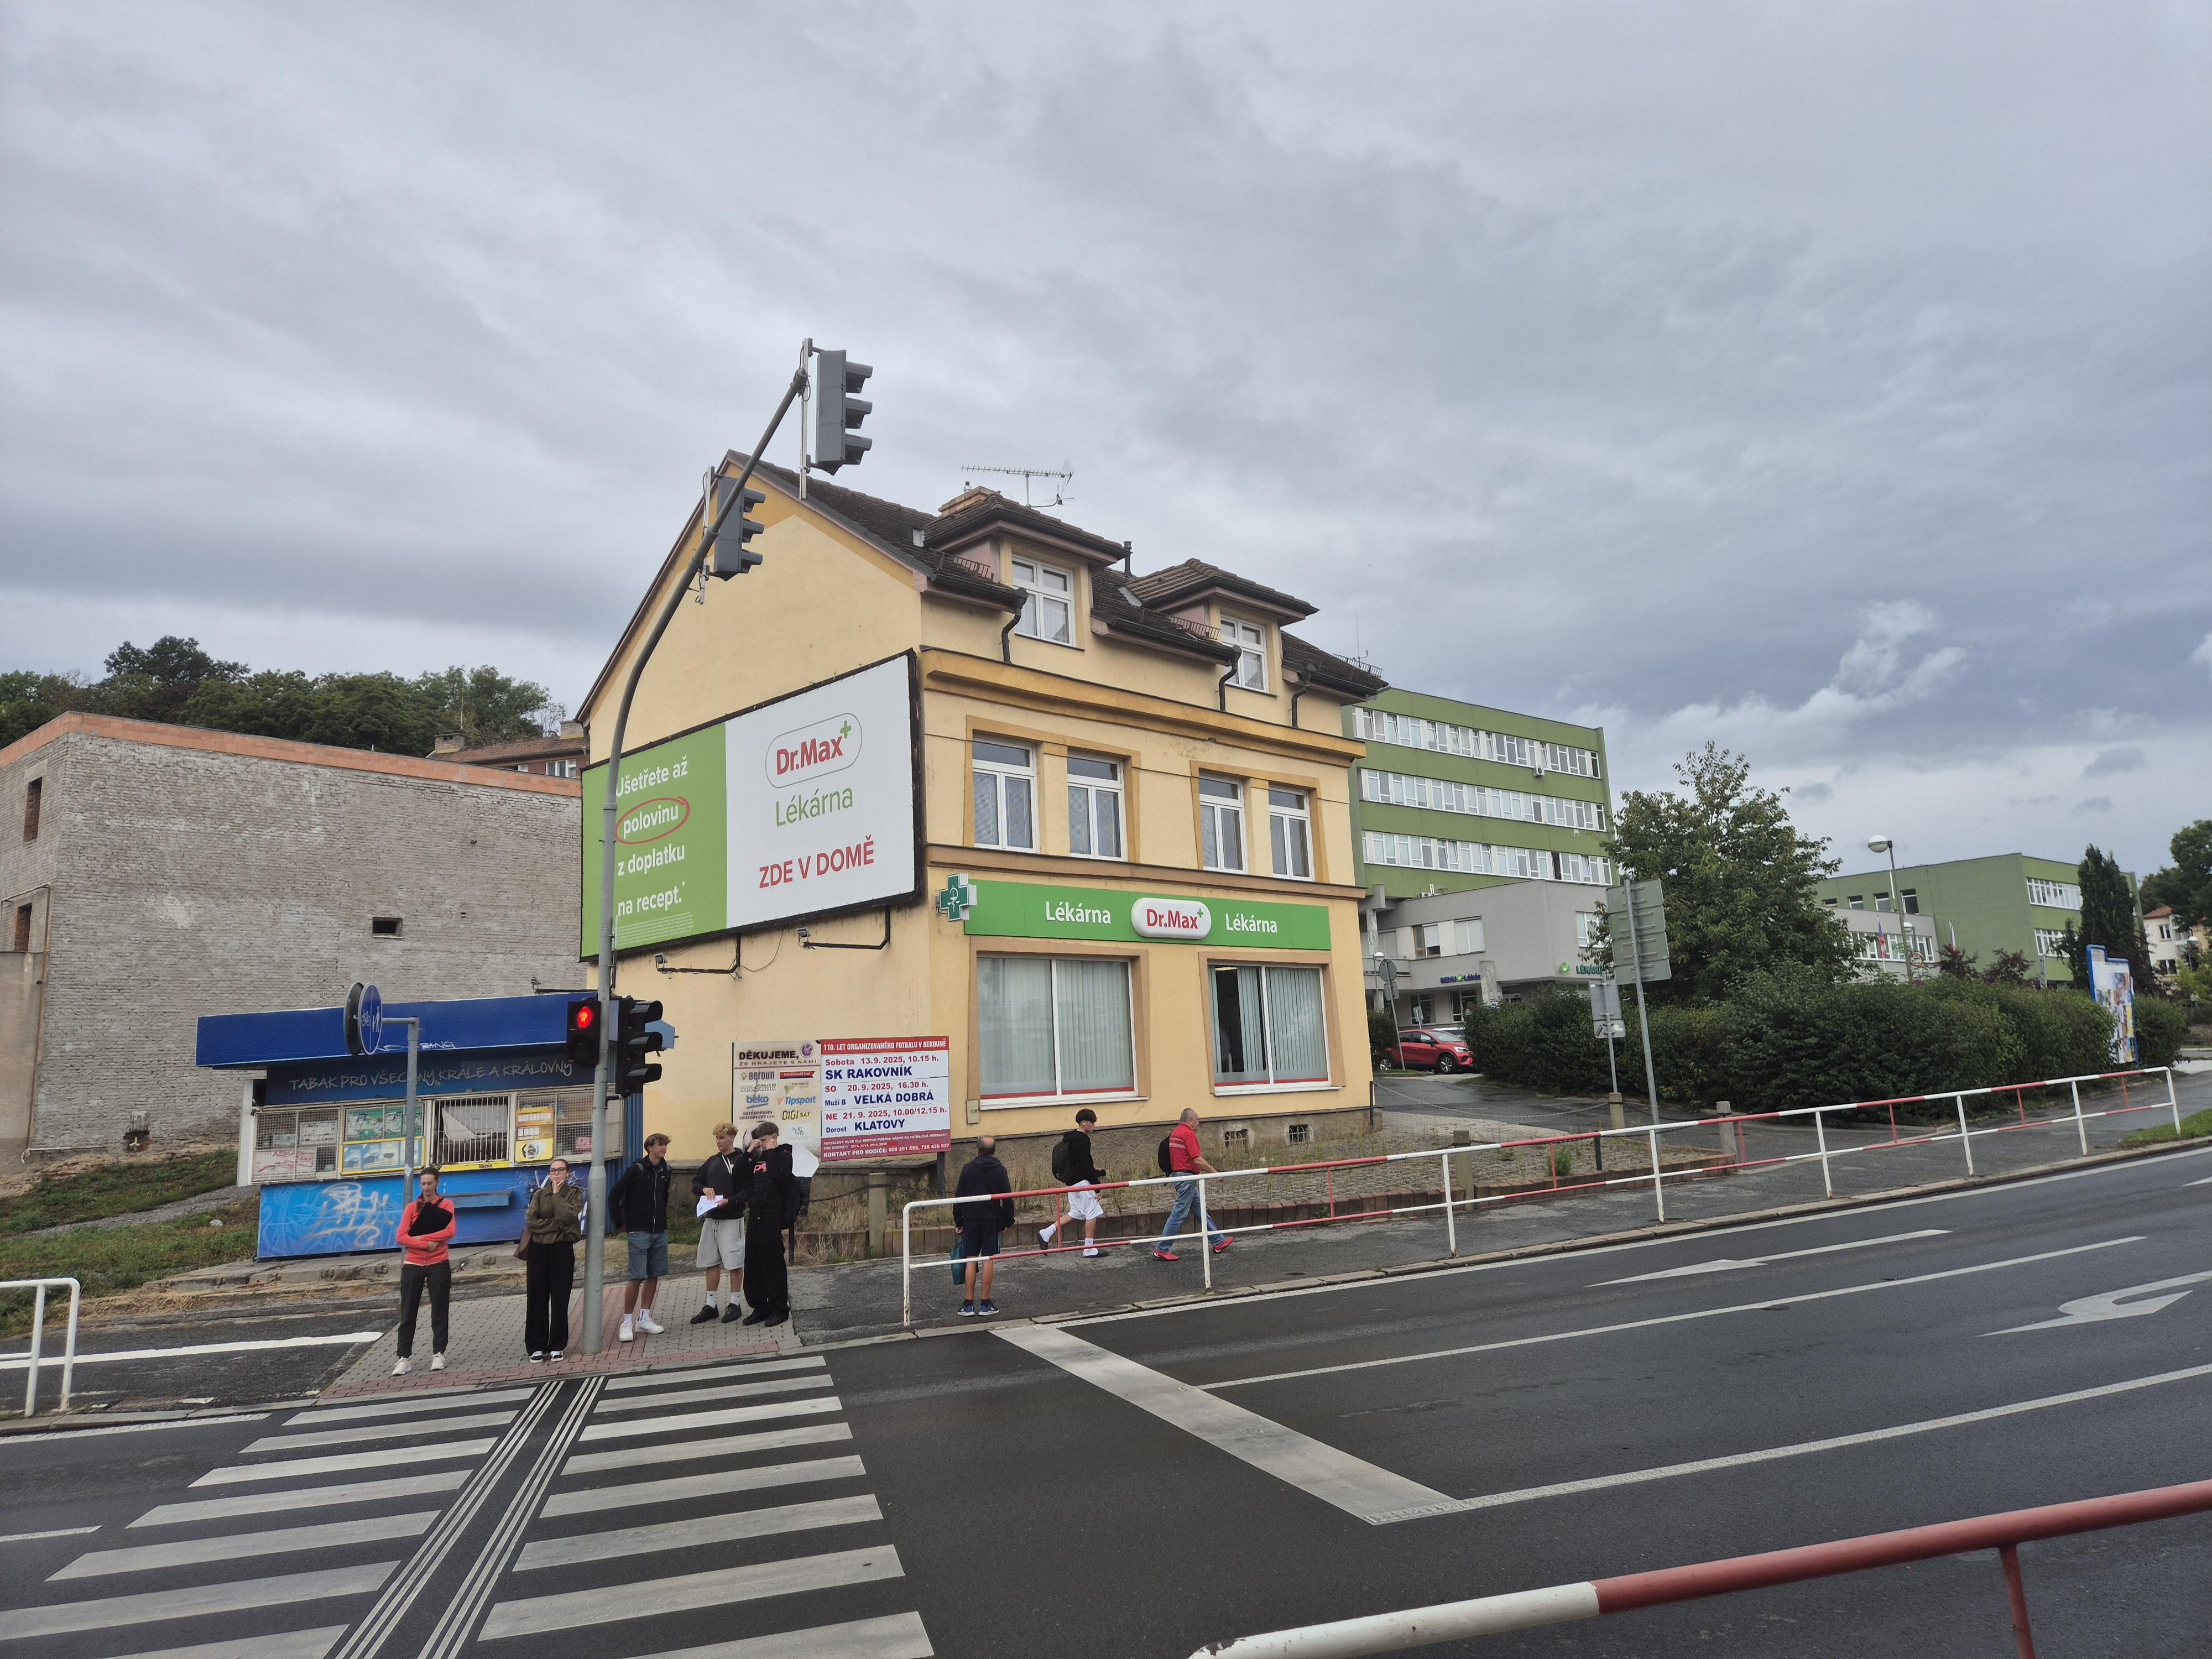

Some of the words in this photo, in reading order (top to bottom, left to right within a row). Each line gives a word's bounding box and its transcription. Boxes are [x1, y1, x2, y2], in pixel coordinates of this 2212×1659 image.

[616, 763, 669, 797] Ušetřete
[672, 755, 688, 778] až
[776, 787, 853, 827] Lékárna
[623, 805, 679, 839] polovinu
[618, 860, 624, 877] z
[628, 844, 685, 875] doplatku
[759, 860, 793, 889] ZDE
[800, 856, 811, 880] V
[817, 834, 875, 876] DOMĚ
[618, 900, 633, 917] na
[1046, 901, 1112, 925] Lékárna
[1225, 914, 1277, 934] Lékárna
[847, 1041, 894, 1050] ORGANIZOVANÉHO
[923, 1039, 947, 1047] BEROUNĚ
[739, 1050, 799, 1060] DĚKUJEME,
[290, 1074, 337, 1091] TABÁK
[341, 1075, 367, 1088] PRO
[371, 1069, 435, 1086] VŠECNY
[439, 1065, 486, 1081] KRÁLE
[489, 1067, 499, 1077] A
[502, 1060, 573, 1077] KRÁLOVNY
[825, 1069, 843, 1080] SK
[847, 1065, 912, 1079] RAKOVNÍK
[747, 1095, 769, 1104] beko
[785, 1096, 816, 1105] Tipsport
[854, 1092, 892, 1105] VELKÁ
[896, 1089, 934, 1102] DOBRÁ
[782, 1110, 799, 1120] DIGI
[893, 1107, 937, 1116] 10.00/12.15
[854, 1119, 905, 1131] KLATOVY
